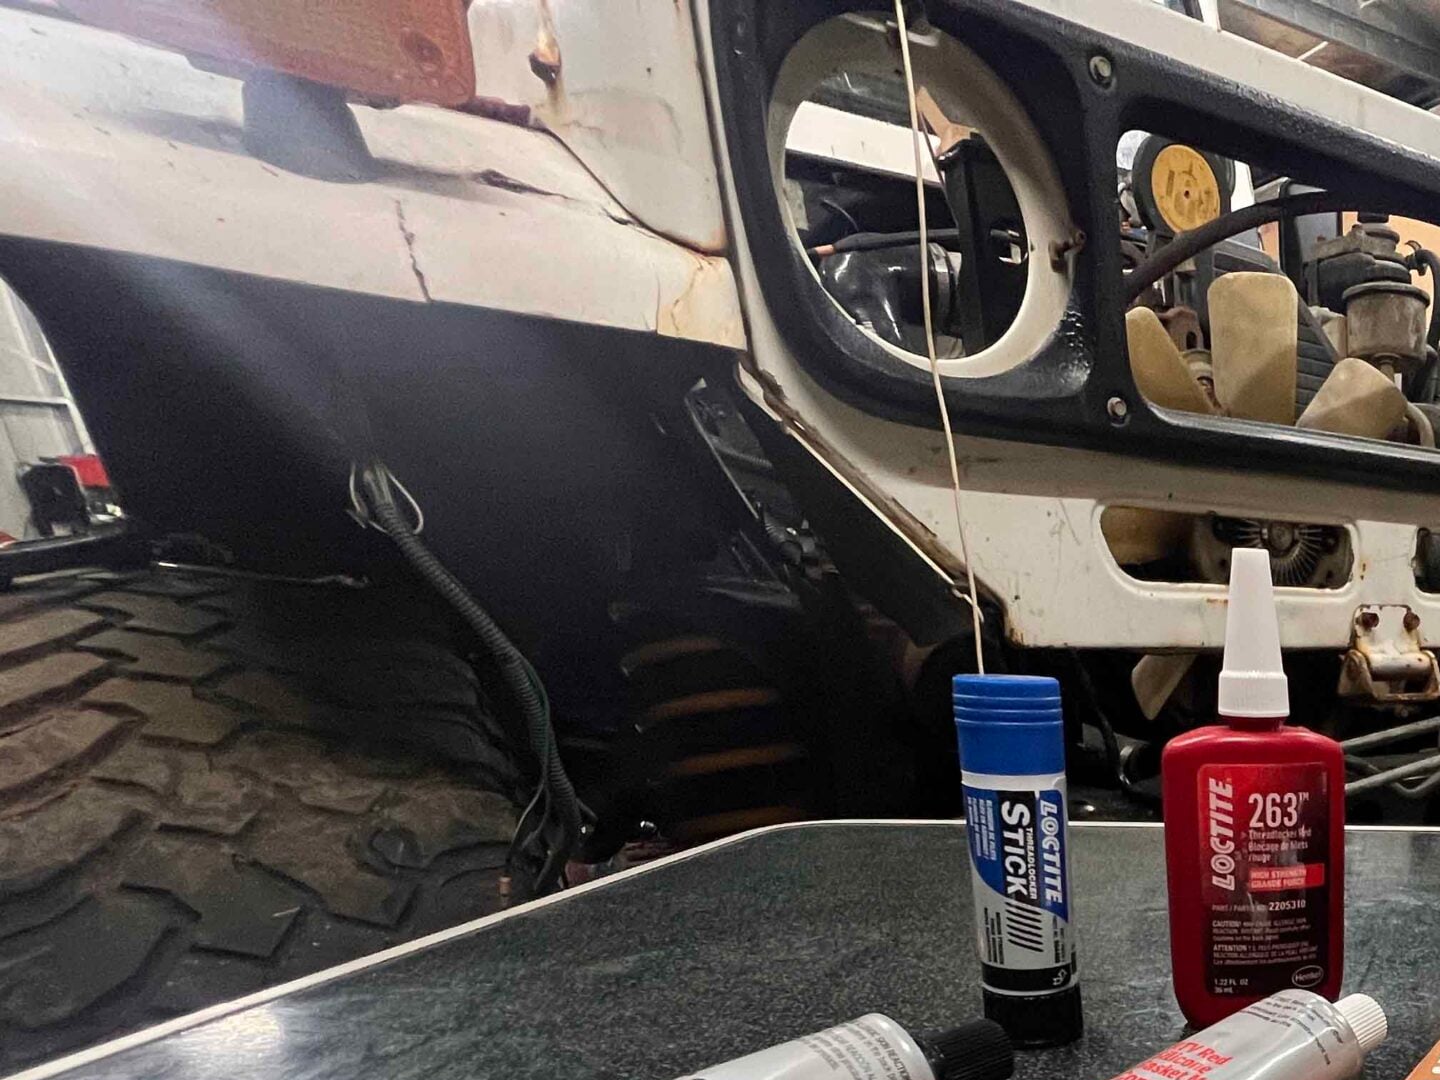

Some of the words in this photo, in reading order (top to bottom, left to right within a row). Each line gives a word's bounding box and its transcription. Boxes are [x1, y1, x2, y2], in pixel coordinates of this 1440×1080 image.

[1001, 801, 1030, 898] STICK
[1026, 828, 1038, 900] THREADLOCKER
[1040, 800, 1062, 903] LOCTITE
[1209, 777, 1235, 891] LOCTITE
[1269, 900, 1306, 911] 2205310
[1199, 1047, 1233, 1065] Red
